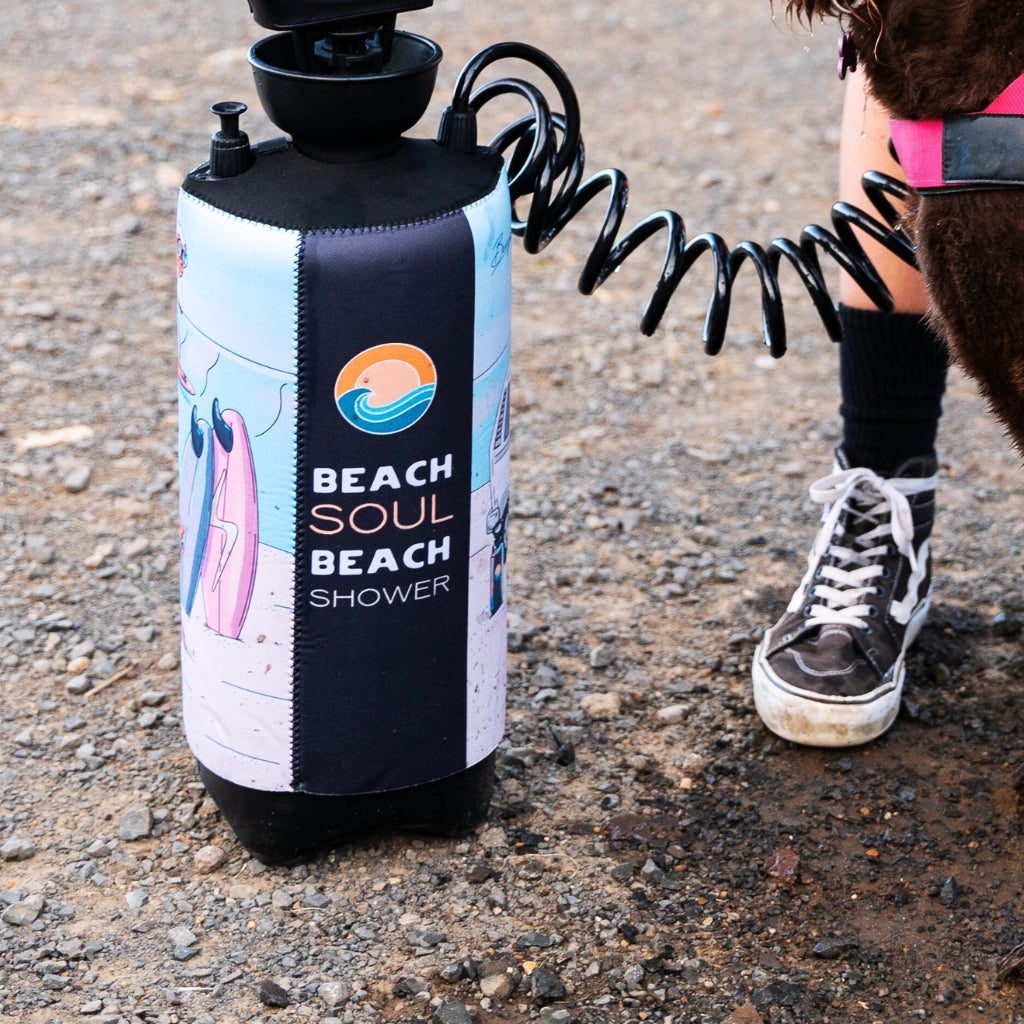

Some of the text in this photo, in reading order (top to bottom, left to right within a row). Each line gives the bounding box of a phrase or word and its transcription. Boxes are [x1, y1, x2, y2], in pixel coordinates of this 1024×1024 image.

[313, 453, 453, 494] BEACH
[309, 493, 454, 535] SOUL
[311, 535, 450, 576] BEACH
[309, 575, 450, 608] SHOWER
